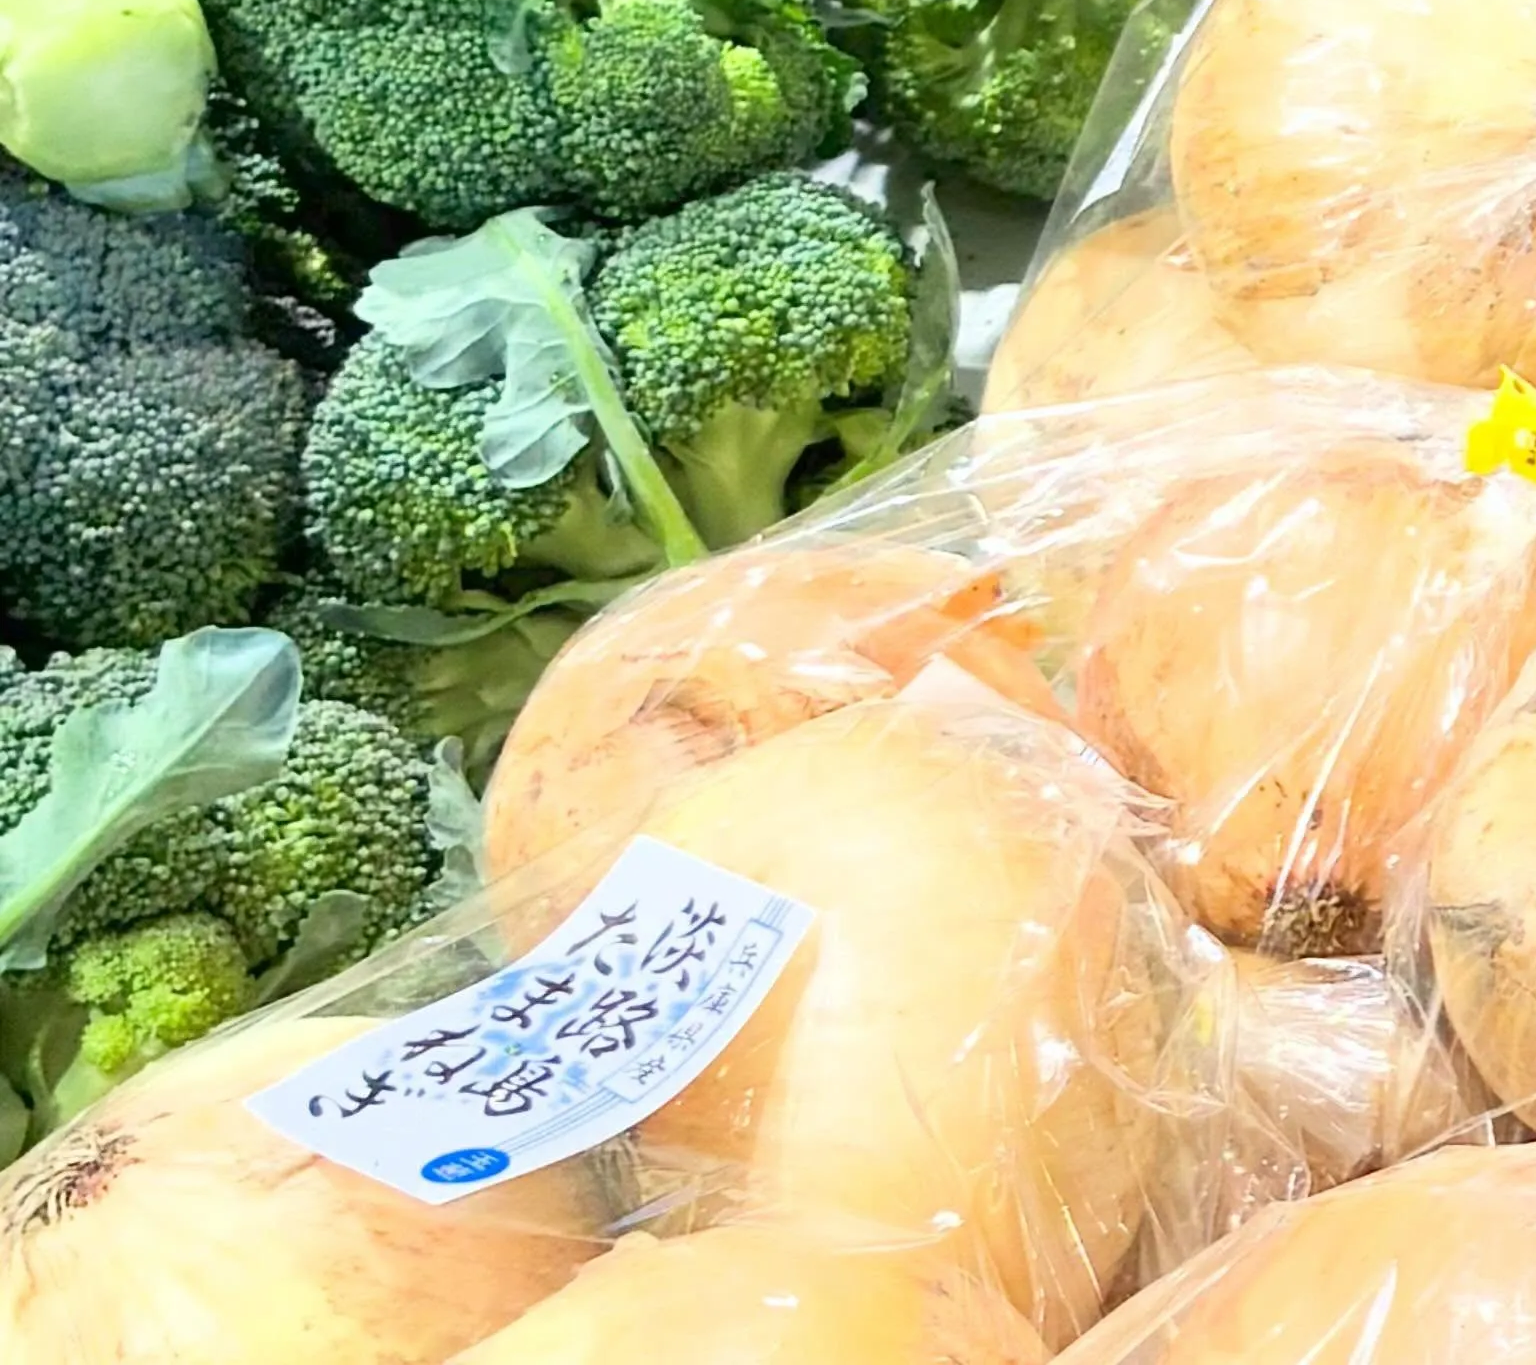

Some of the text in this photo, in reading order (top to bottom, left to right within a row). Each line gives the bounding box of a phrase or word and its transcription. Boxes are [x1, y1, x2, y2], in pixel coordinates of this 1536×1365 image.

[309, 899, 639, 1119] たまねぎ
[460, 896, 727, 1117] 淡路島
